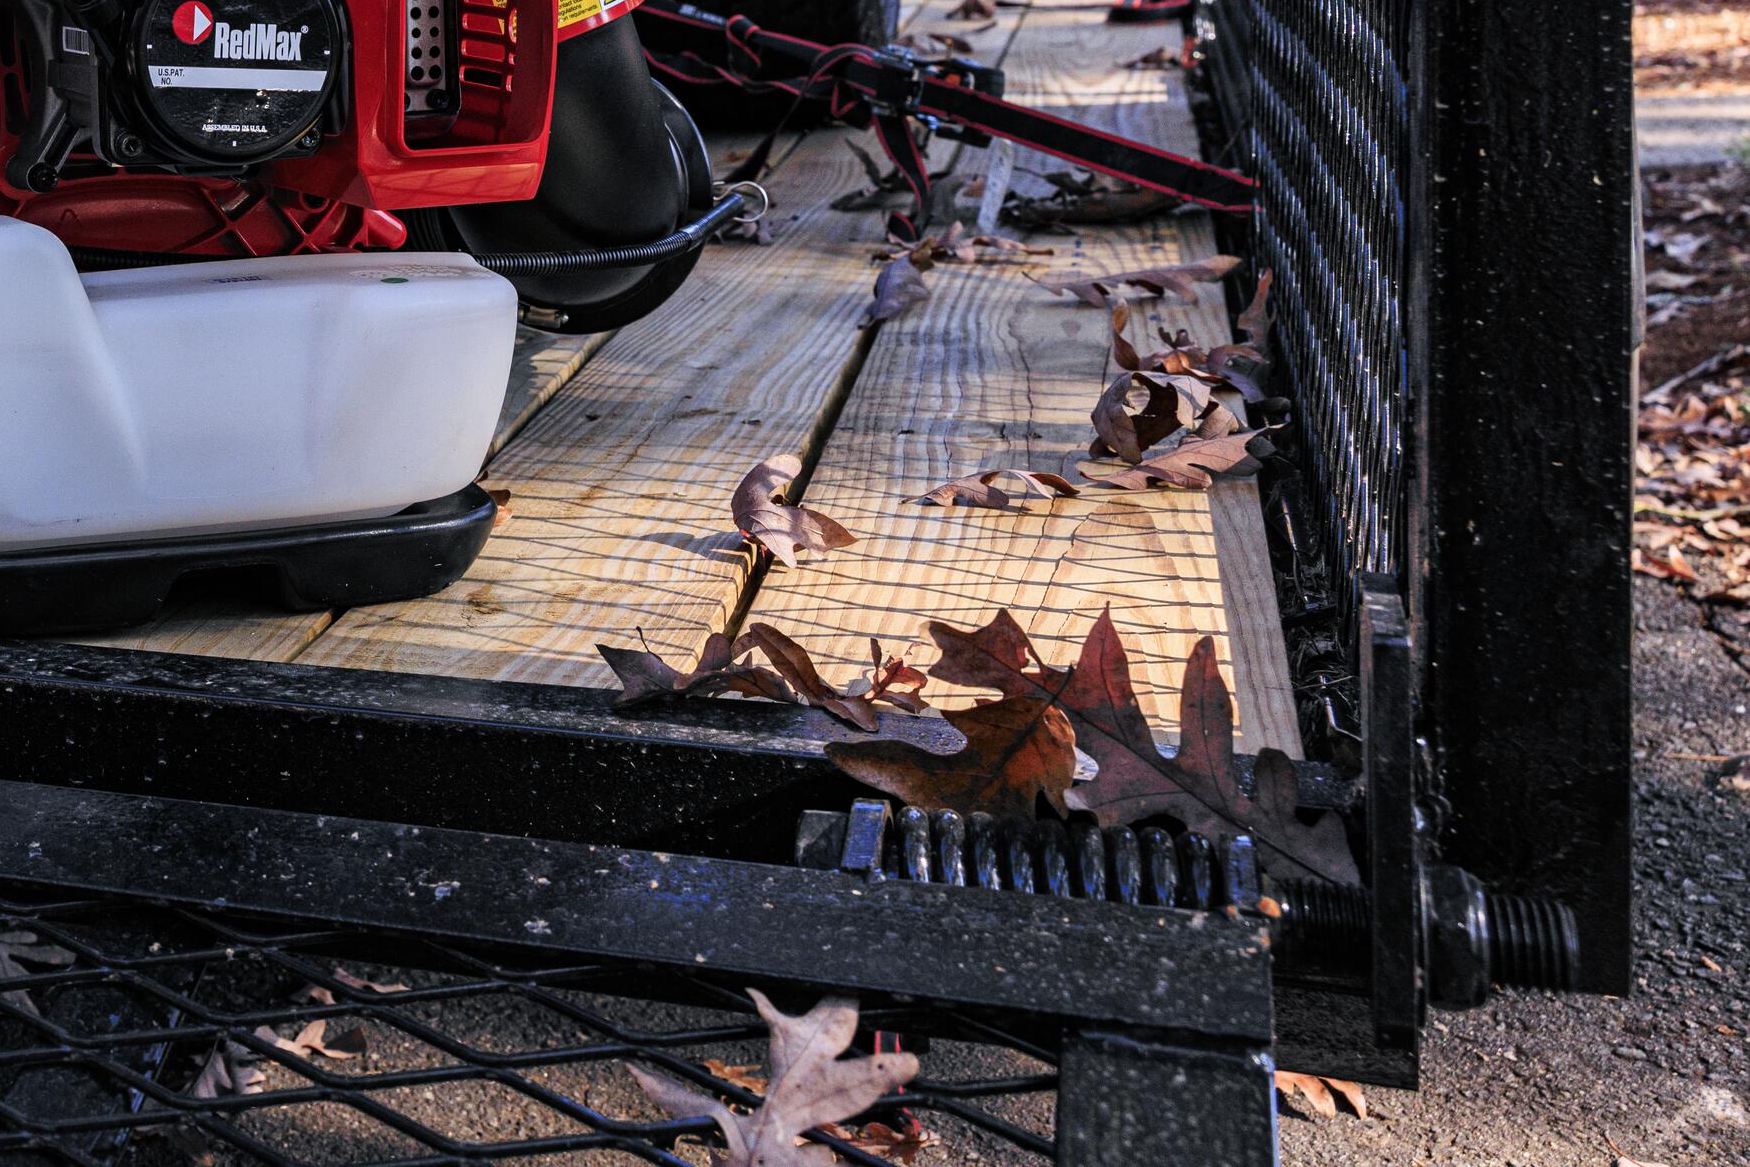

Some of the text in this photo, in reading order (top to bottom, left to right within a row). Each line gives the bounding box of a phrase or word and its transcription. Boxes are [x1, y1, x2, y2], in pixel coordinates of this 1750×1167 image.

[214, 22, 301, 61] RedMax
[158, 68, 185, 77] U.S.PAT.
[161, 77, 172, 86] NO.
[202, 124, 268, 133] ASSEMBLED IN U.S.A.
